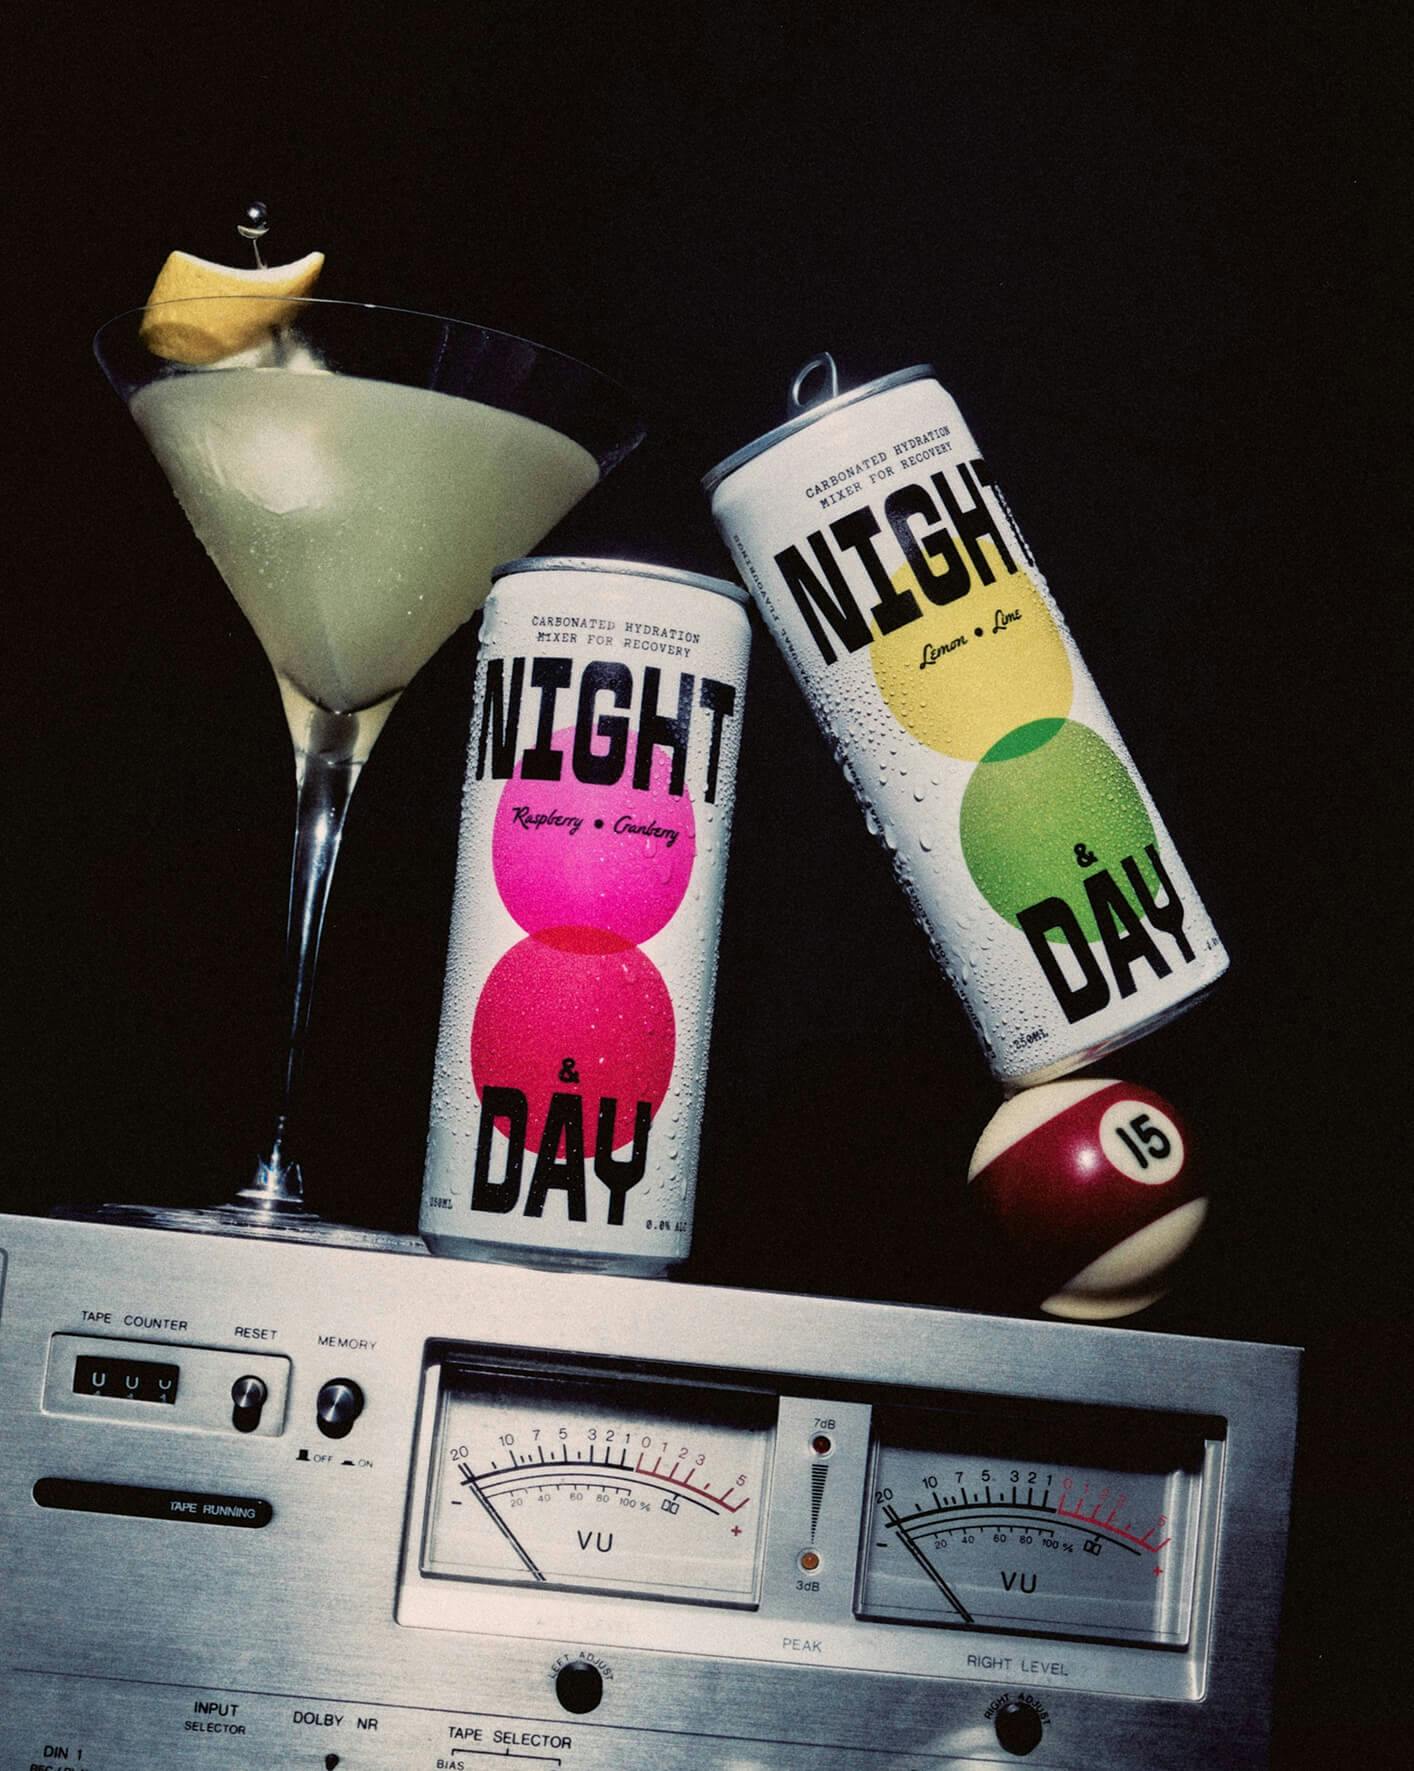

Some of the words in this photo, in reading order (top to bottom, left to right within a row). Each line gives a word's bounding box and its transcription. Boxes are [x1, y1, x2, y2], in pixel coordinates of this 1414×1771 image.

[805, 451, 887, 498] CARBONATED
[893, 425, 951, 456] HYDRATION
[819, 481, 863, 509] MIXER
[869, 466, 895, 485] FOR
[900, 441, 953, 470] RECOVERY
[774, 459, 1034, 667] NIGHT
[531, 616, 615, 630] CARBONATED
[624, 621, 700, 644] HYDRATION
[919, 635, 968, 670] Lemon
[992, 609, 1022, 634] Lime
[537, 632, 577, 643] MIXER
[587, 634, 613, 646] FOR
[624, 638, 691, 658] RECOVERY
[475, 657, 736, 804] NIGHT
[512, 806, 584, 835] Raspberry
[614, 815, 680, 848] Cranberry
[1073, 843, 1098, 868] &
[1016, 844, 1196, 1024] DAY
[559, 1058, 580, 1083] &
[1115, 1113, 1171, 1169] 15
[471, 1085, 652, 1226] DAY
[81, 1310, 112, 1325] TAPE
[123, 1315, 188, 1332] COUNTER
[234, 1326, 278, 1341] RESET
[317, 1336, 377, 1351] MEMORY
[814, 1417, 836, 1431] 7dB
[314, 1454, 333, 1464] OFF
[358, 1458, 373, 1469] ON
[450, 1445, 469, 1461] 20
[499, 1433, 514, 1446] 10
[532, 1429, 541, 1440] 7
[559, 1428, 568, 1440] 5
[588, 1428, 597, 1440] 3
[606, 1430, 615, 1442] 2
[625, 1433, 630, 1444] 1
[641, 1436, 651, 1448] 0
[661, 1442, 668, 1452] 1
[678, 1447, 688, 1459] 2
[695, 1454, 705, 1466] 3
[736, 1474, 747, 1486] 5
[875, 1488, 893, 1504] 20
[923, 1476, 938, 1489] 10
[955, 1472, 963, 1483] 7
[982, 1470, 991, 1482] 5
[1010, 1470, 1019, 1483] 3
[1028, 1472, 1037, 1484] 2
[1046, 1475, 1052, 1485] 1
[169, 1500, 197, 1513] TAPE
[203, 1503, 256, 1519] RUNNING
[511, 1499, 523, 1508] 20
[538, 1494, 551, 1502] 40
[570, 1492, 583, 1501] 60
[596, 1494, 609, 1503] 80
[619, 1497, 636, 1508] 100
[576, 1529, 613, 1553] VU
[935, 1540, 947, 1549] 20
[961, 1535, 974, 1544] 40
[994, 1534, 1006, 1543] 60
[1019, 1535, 1032, 1544] 80
[1043, 1538, 1059, 1549] 100
[796, 1580, 820, 1593] 3dB
[1001, 1571, 1037, 1594] VU
[783, 1637, 822, 1653] PEAK
[548, 1654, 569, 1679] LEFT
[579, 1651, 613, 1680] ADJUST
[967, 1654, 1012, 1671] RIGHT
[1021, 1660, 1069, 1677] LEVEL
[194, 1702, 238, 1717] INPUT
[984, 1693, 1010, 1719] RIGHT
[1018, 1692, 1051, 1725] ADJUST
[184, 1720, 246, 1735] SELECTOR
[293, 1711, 344, 1727] DOLBY
[357, 1717, 378, 1730] NR
[448, 1726, 482, 1741] TAPE
[493, 1730, 572, 1749] SELECTOR
[44, 1745, 68, 1760] DIN
[78, 1749, 82, 1760] 1
[436, 1760, 464, 1771] BIAS
